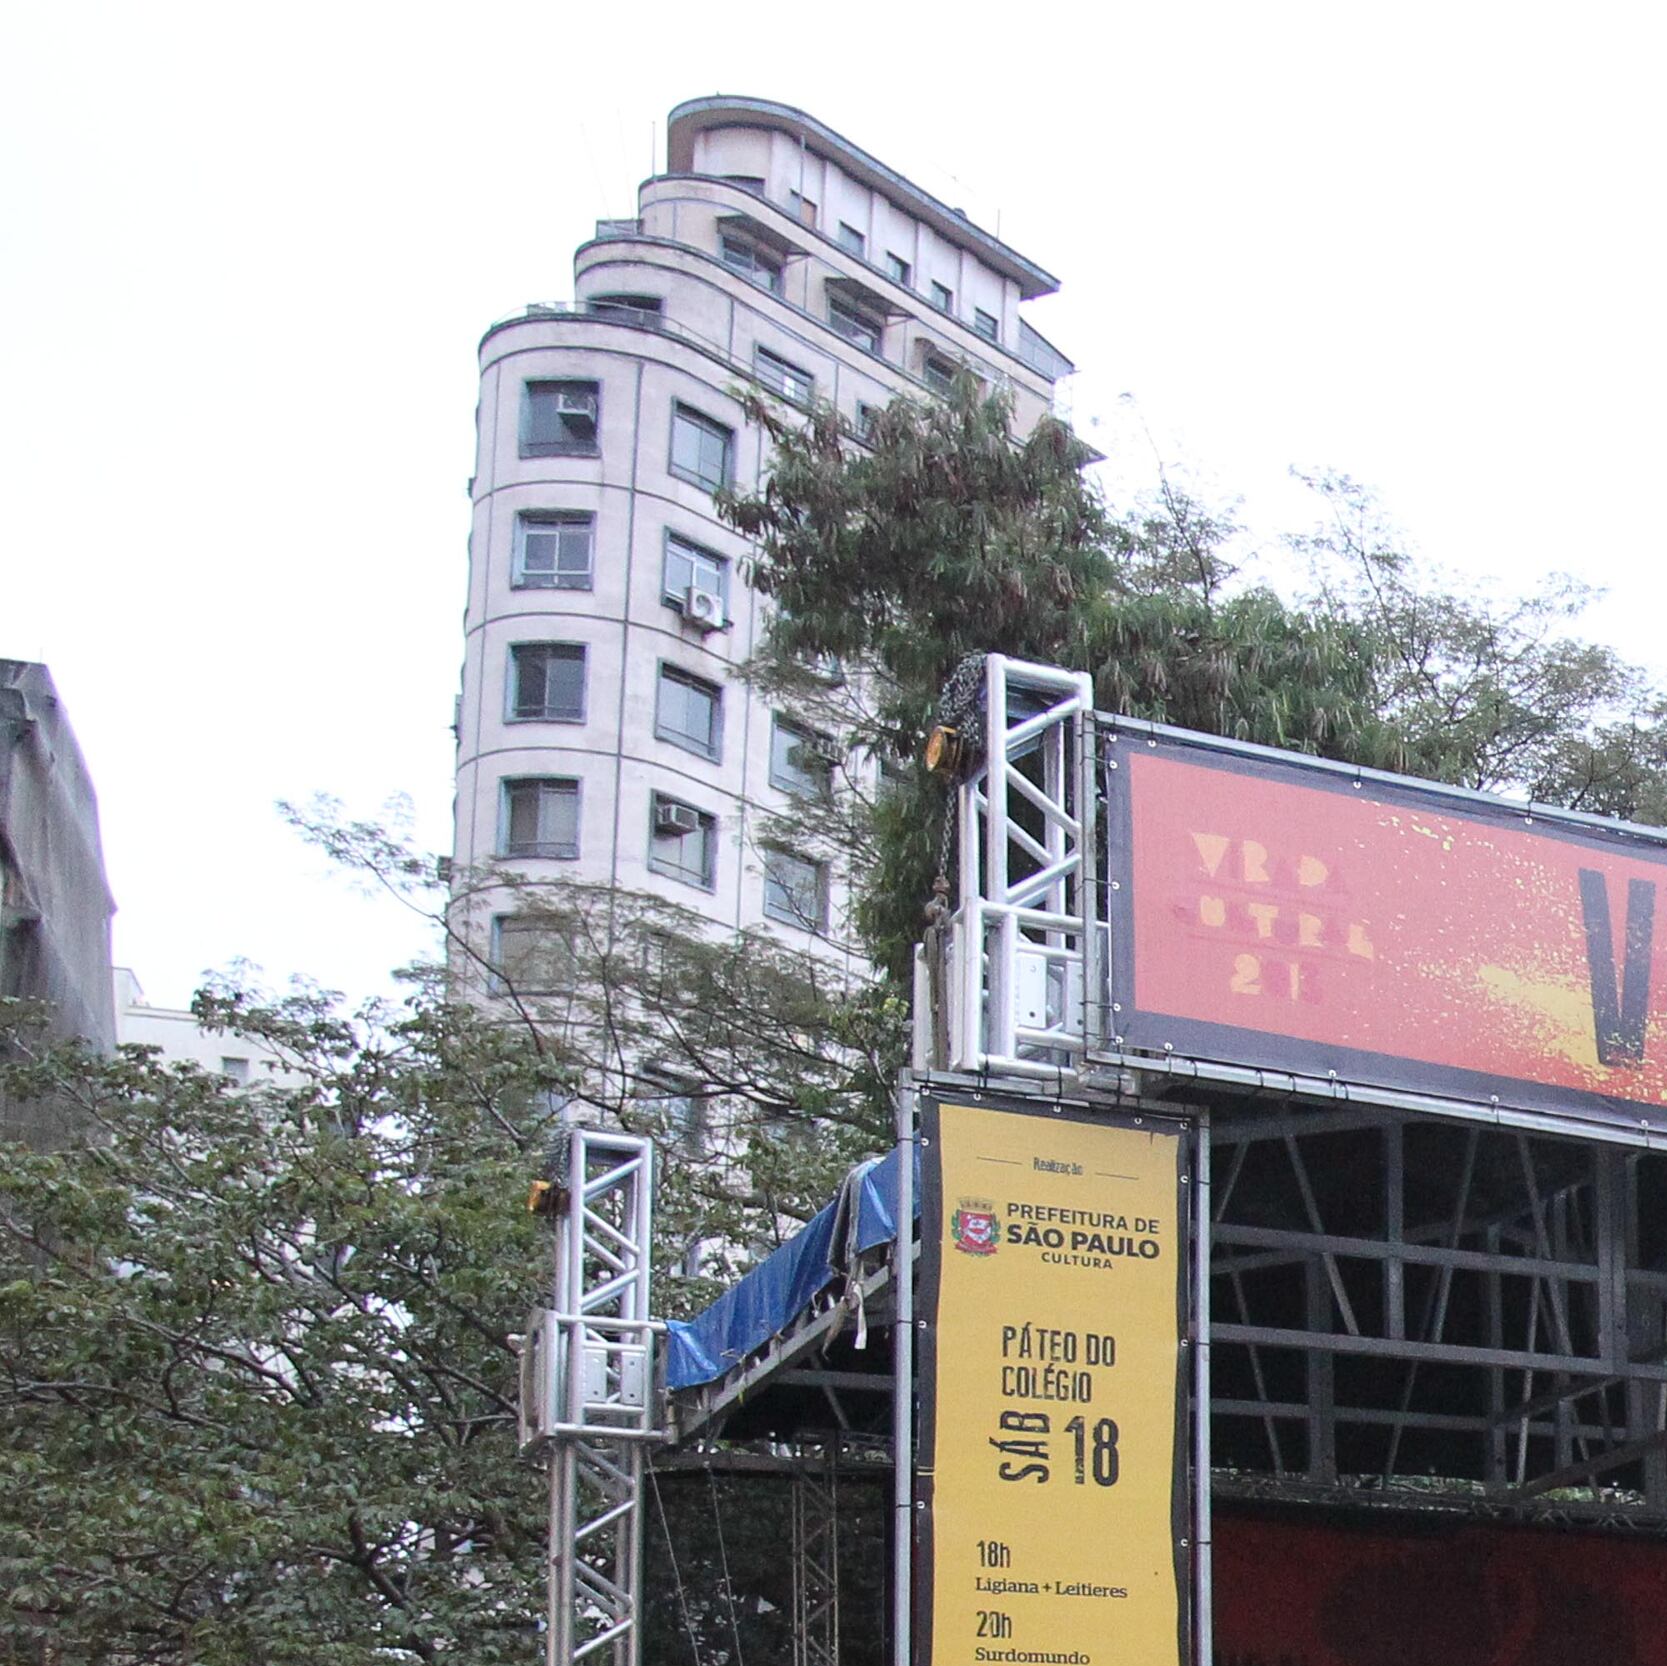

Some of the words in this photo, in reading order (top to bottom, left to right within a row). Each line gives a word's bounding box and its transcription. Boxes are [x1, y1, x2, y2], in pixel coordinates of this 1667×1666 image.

[1033, 1156, 1083, 1176] Realização
[1007, 1203, 1128, 1231] PREFEITURA
[1134, 1218, 1160, 1234] DE
[1007, 1222, 1064, 1249] SÃO
[1071, 1231, 1160, 1260] PAULO
[1041, 1252, 1113, 1270] CULTURA
[1003, 1321, 1077, 1364] PÁTEO
[1086, 1333, 1116, 1367] DO
[1002, 1364, 1092, 1403] COLÉGIO
[989, 1410, 1051, 1484] SÁB
[1064, 1415, 1120, 1487] 18
[976, 1540, 1011, 1568] 18h
[976, 1577, 1039, 1595] Ligiana
[1055, 1581, 1128, 1599] Leitieres
[976, 1611, 1012, 1639] 20h
[975, 1647, 1090, 1665] Surdomundo
